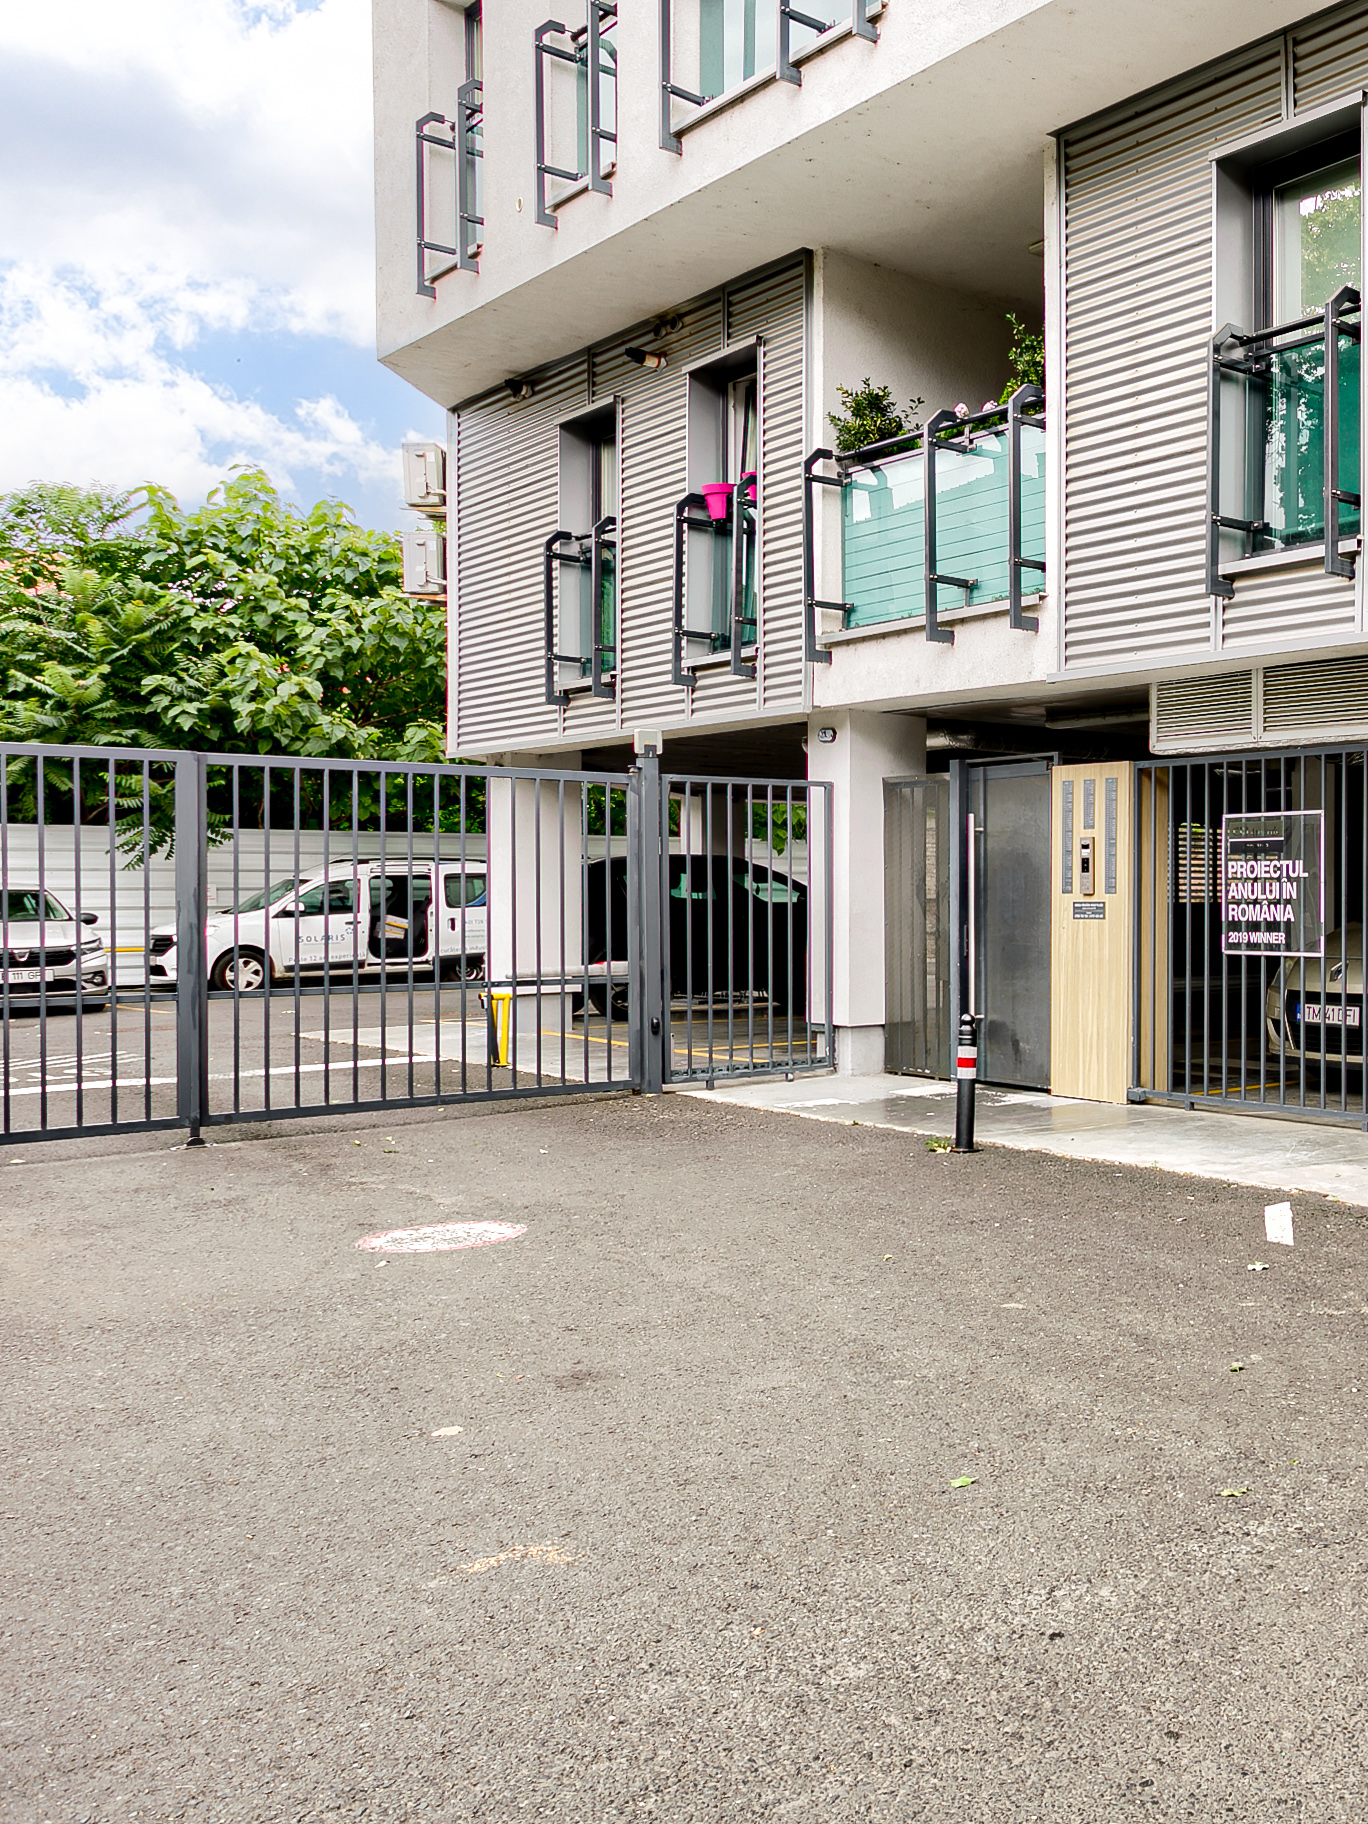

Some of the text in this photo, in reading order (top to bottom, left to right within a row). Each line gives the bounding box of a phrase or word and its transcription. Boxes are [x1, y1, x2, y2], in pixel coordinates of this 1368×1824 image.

[1227, 860, 1309, 878] PROIECTUL
[1227, 878, 1297, 900] ANULUI ÎN
[1228, 900, 1295, 922] ROMÂNIA
[1228, 932, 1286, 945] 2019 WINNER
[1306, 1006, 1321, 1020] TM
